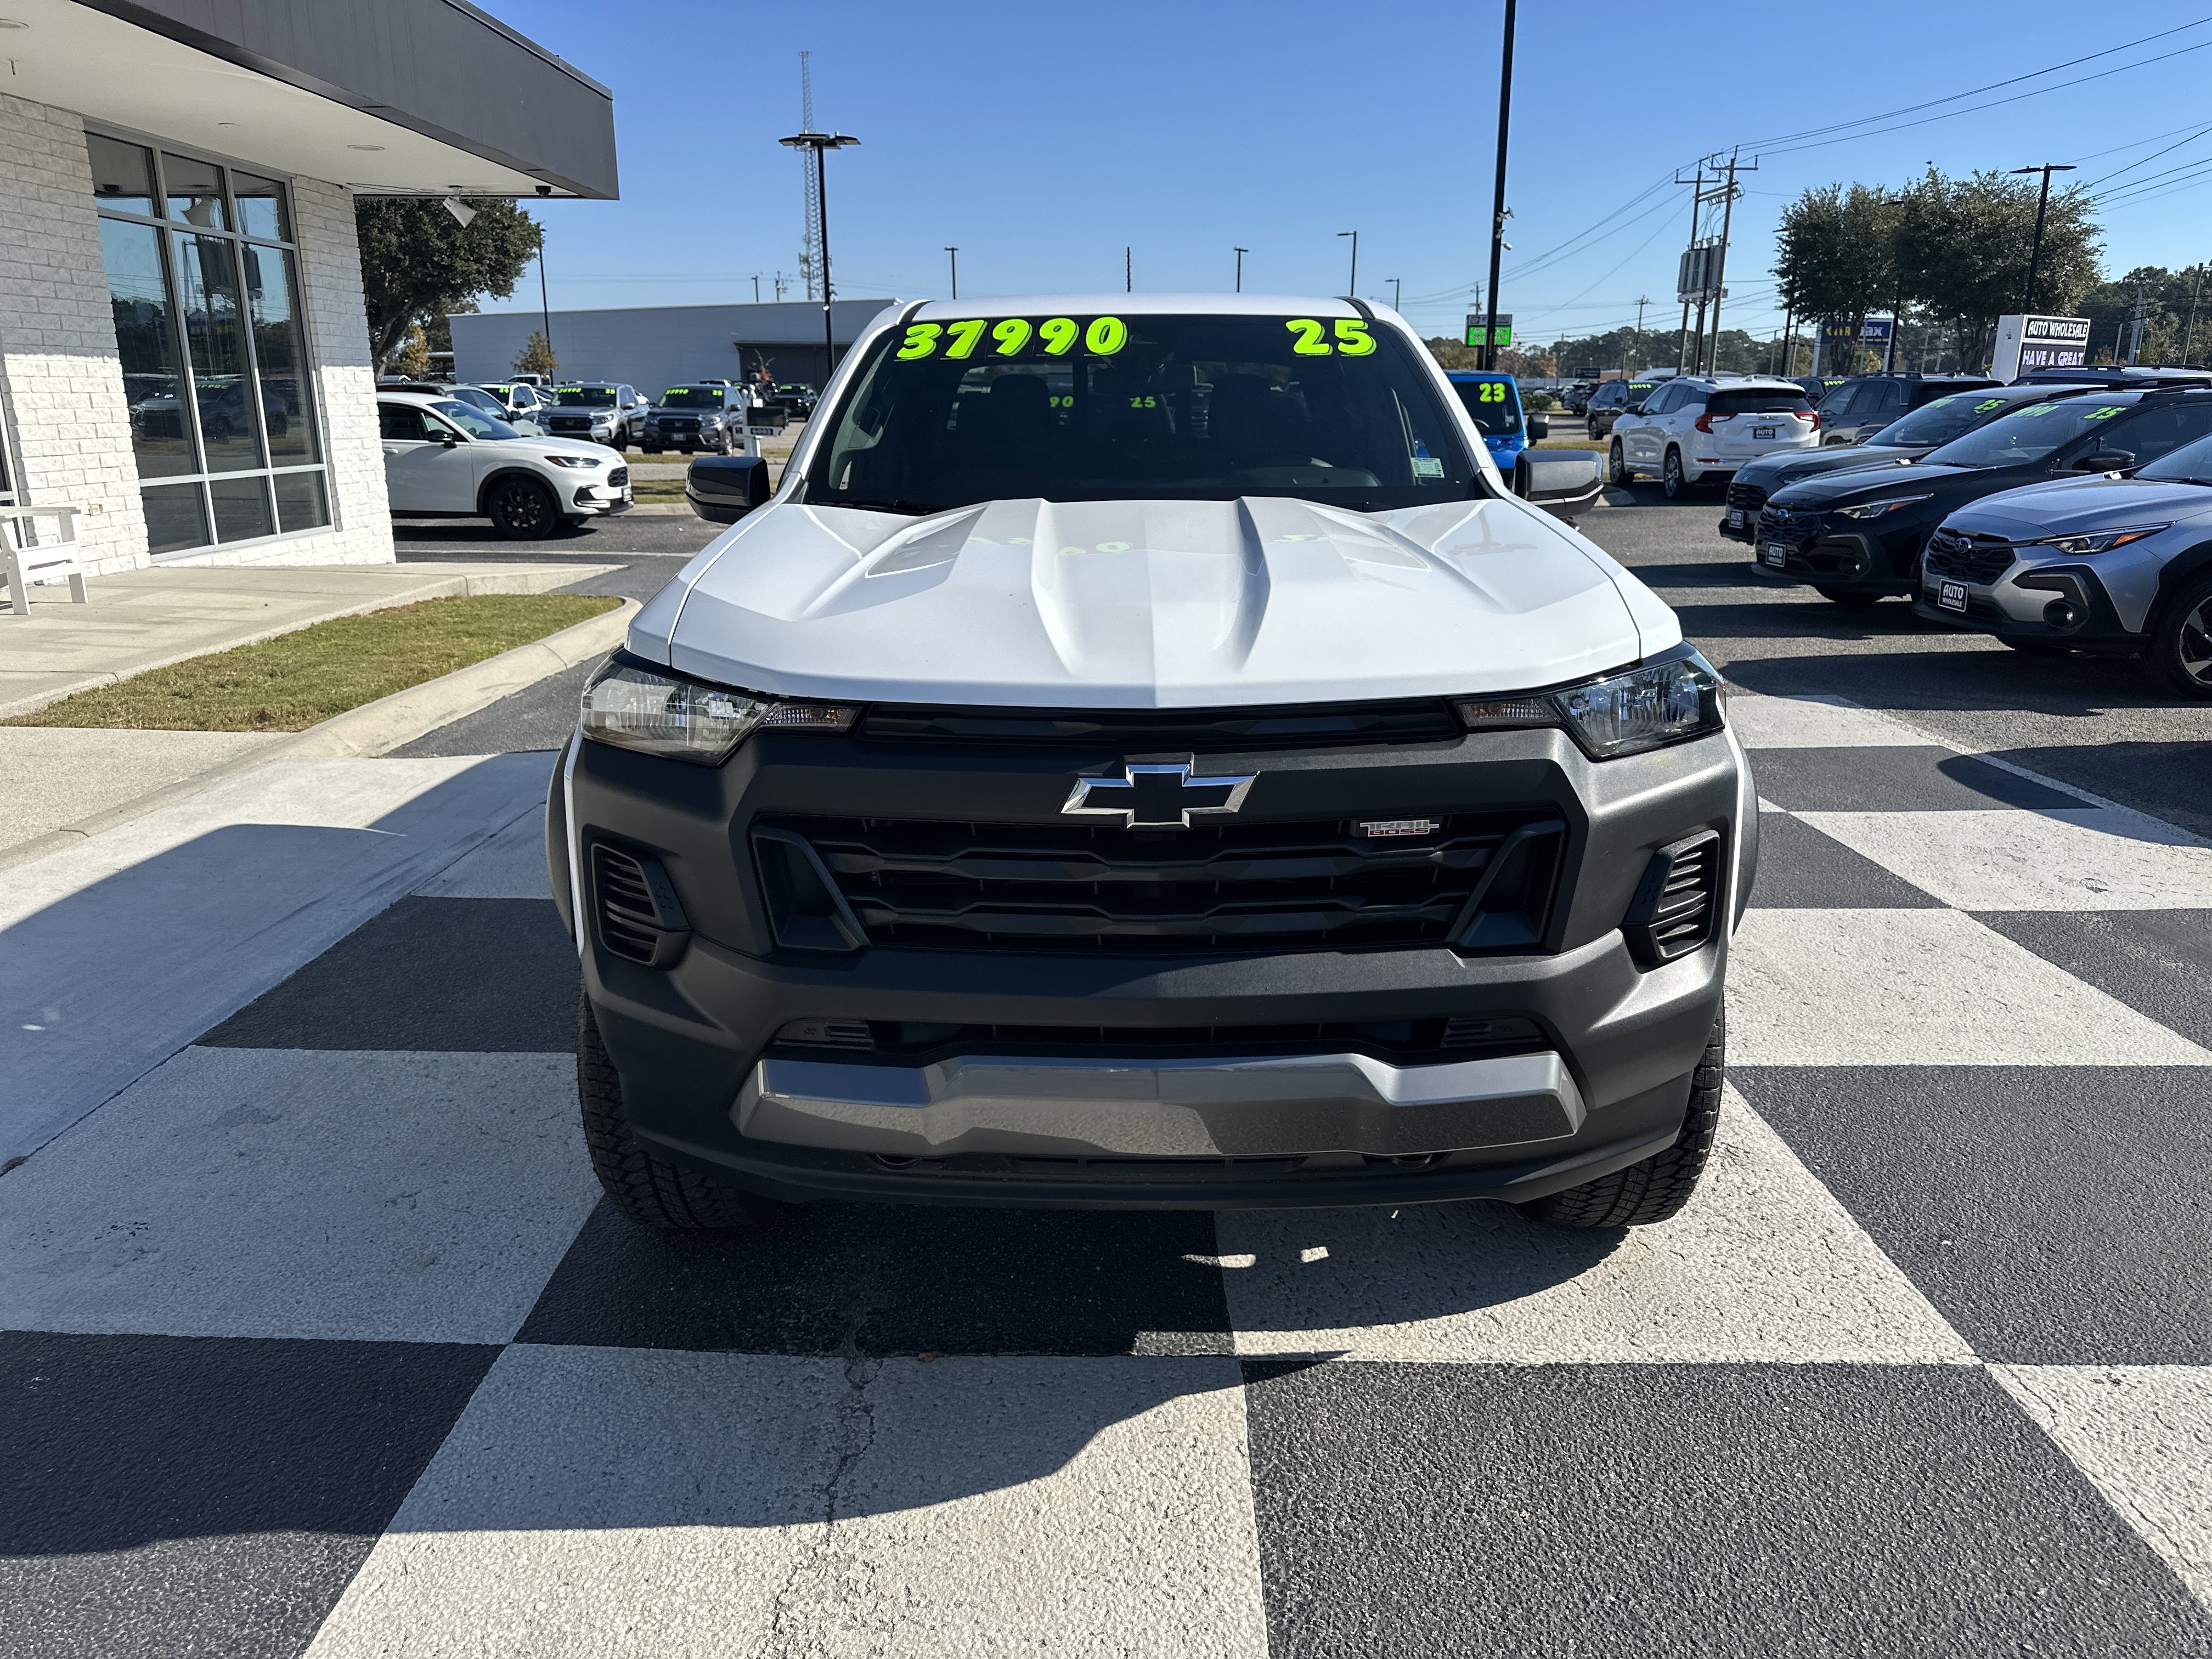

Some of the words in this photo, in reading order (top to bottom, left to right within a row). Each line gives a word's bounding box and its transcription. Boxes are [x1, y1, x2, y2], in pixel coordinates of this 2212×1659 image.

[2028, 320, 2049, 336] AUTO
[2049, 321, 2087, 338] WHOLESALE
[896, 317, 1127, 360] 37990
[1285, 318, 1377, 357] 25
[2022, 350, 2047, 365] HAVE
[2048, 351, 2055, 366] A
[2057, 351, 2084, 366] GREAT
[1479, 383, 1506, 403] 23
[1130, 396, 1156, 409] 25
[1974, 399, 2006, 411] 25
[2084, 407, 2126, 420] 25
[1769, 546, 1783, 558] AUTO
[1943, 584, 1964, 600] AUTO
[1942, 596, 1962, 607] WHOLESALE
[1359, 819, 1440, 830] TRAIL
[1369, 827, 1429, 836] BOSS
